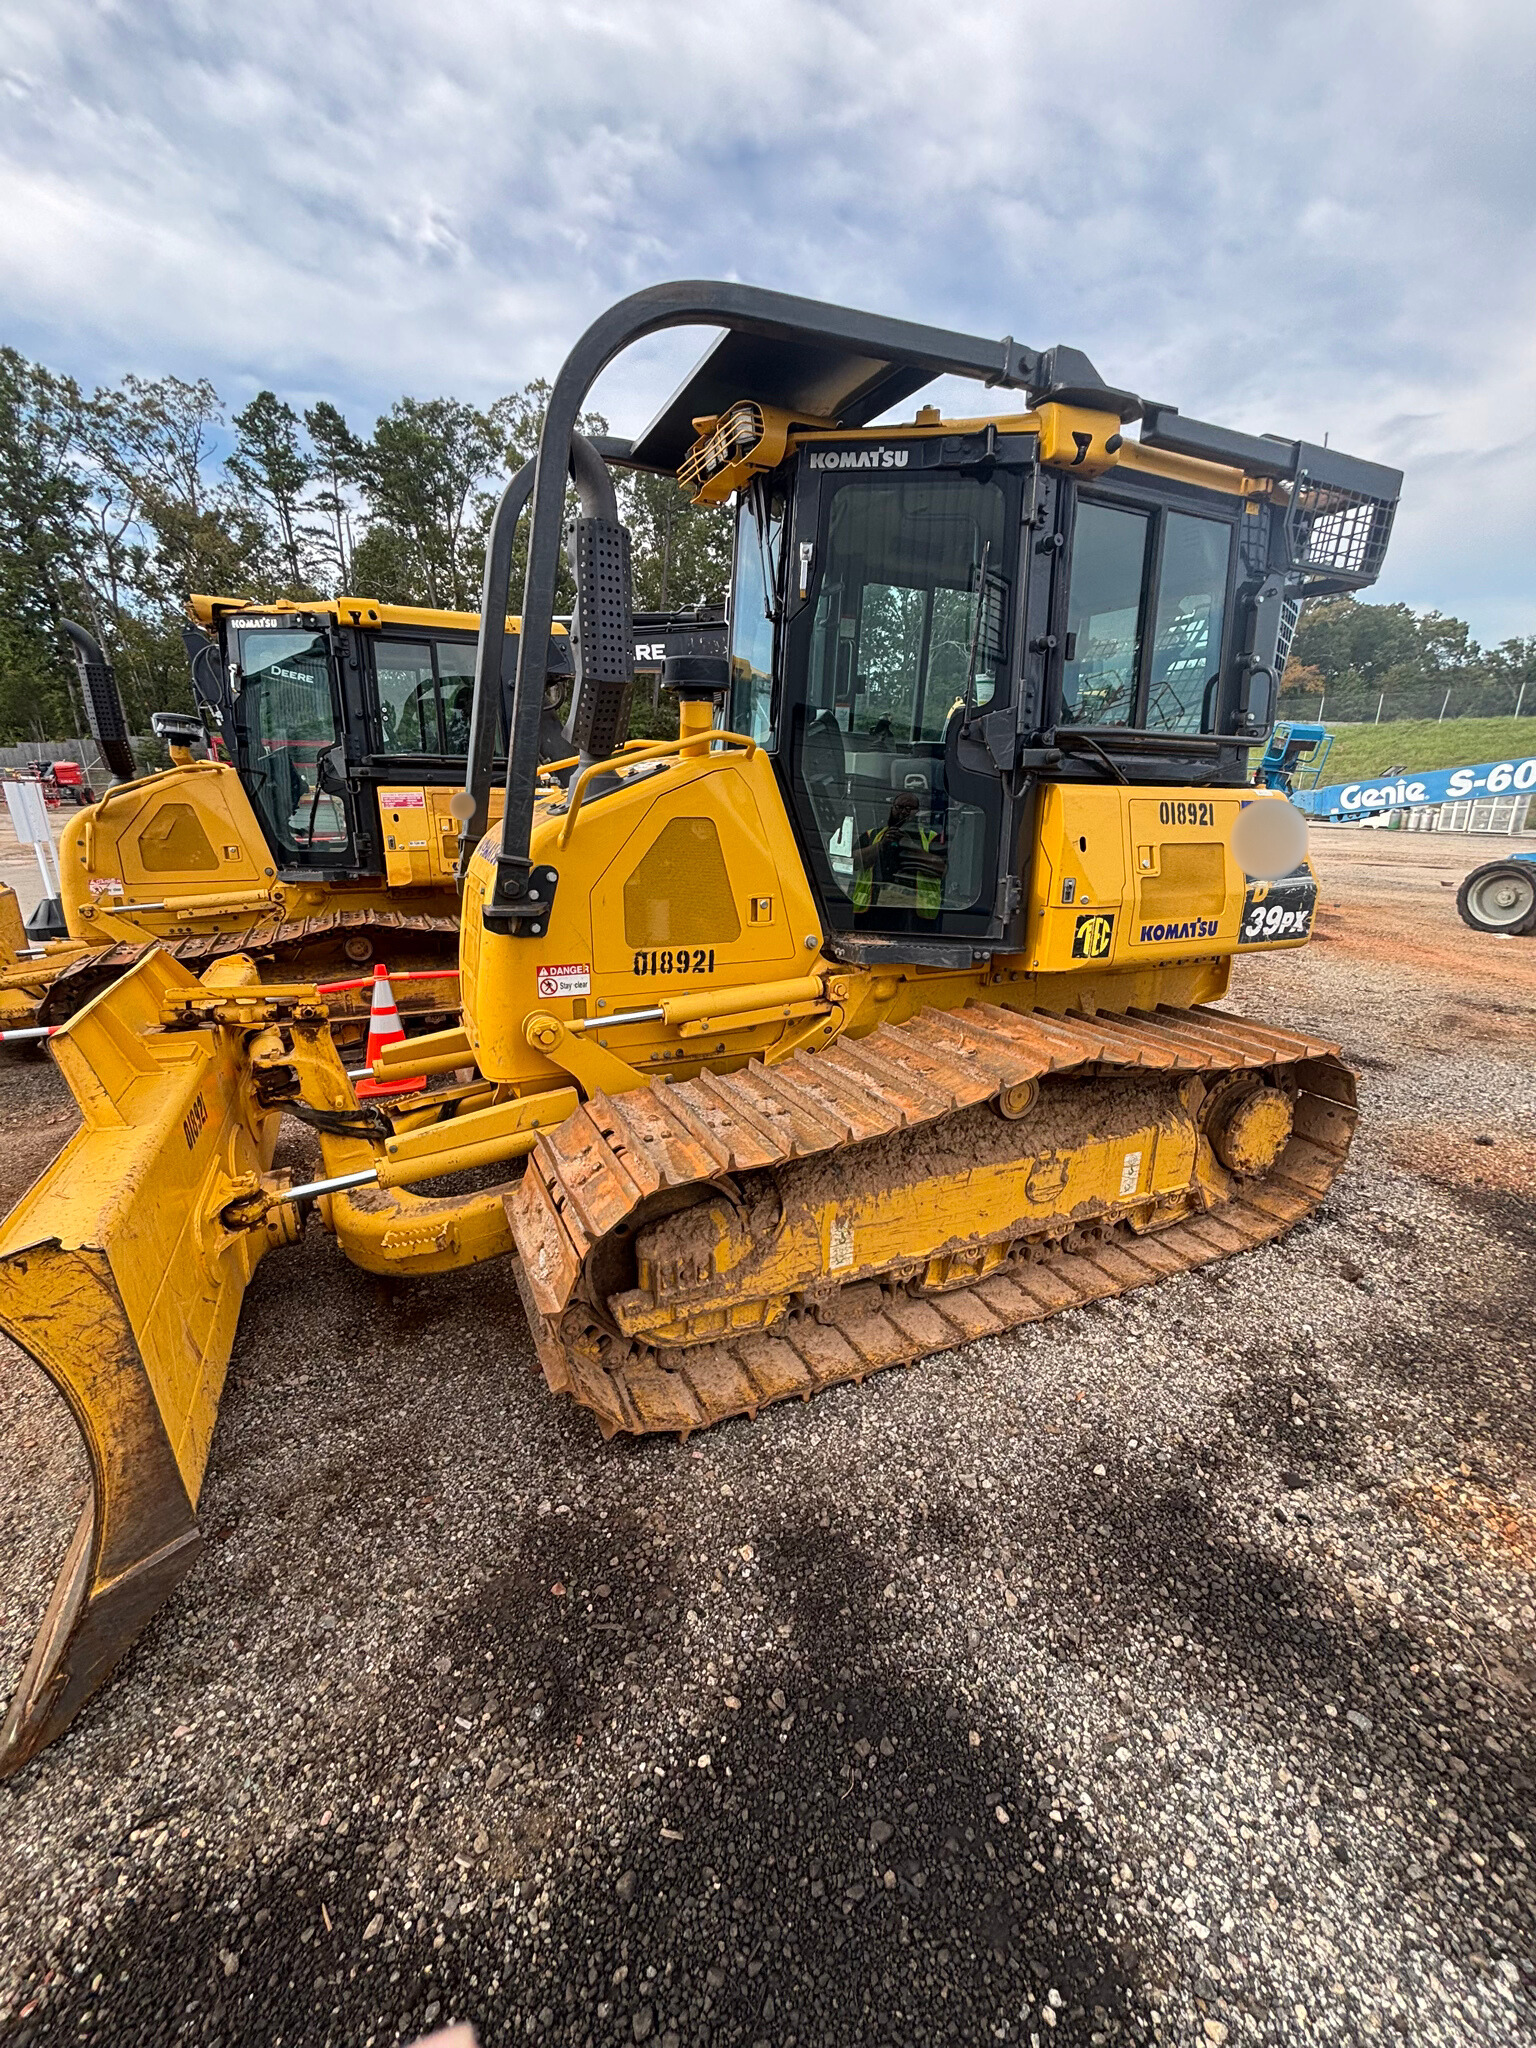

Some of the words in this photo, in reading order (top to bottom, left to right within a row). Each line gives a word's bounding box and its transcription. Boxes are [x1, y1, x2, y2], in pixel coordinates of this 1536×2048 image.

[810, 446, 909, 469] KOMATSU
[231, 617, 278, 628] KOMATSU
[271, 665, 314, 683] DEERE
[1340, 778, 1427, 810] Genie
[1446, 759, 1536, 797] S-60
[1160, 802, 1214, 826] 018921
[1140, 917, 1219, 942] KOMATSU
[550, 964, 589, 976] DANGER
[633, 949, 715, 976] 018921
[559, 982, 573, 991] Stay
[574, 981, 588, 989] clear
[183, 1091, 208, 1151] 018921
